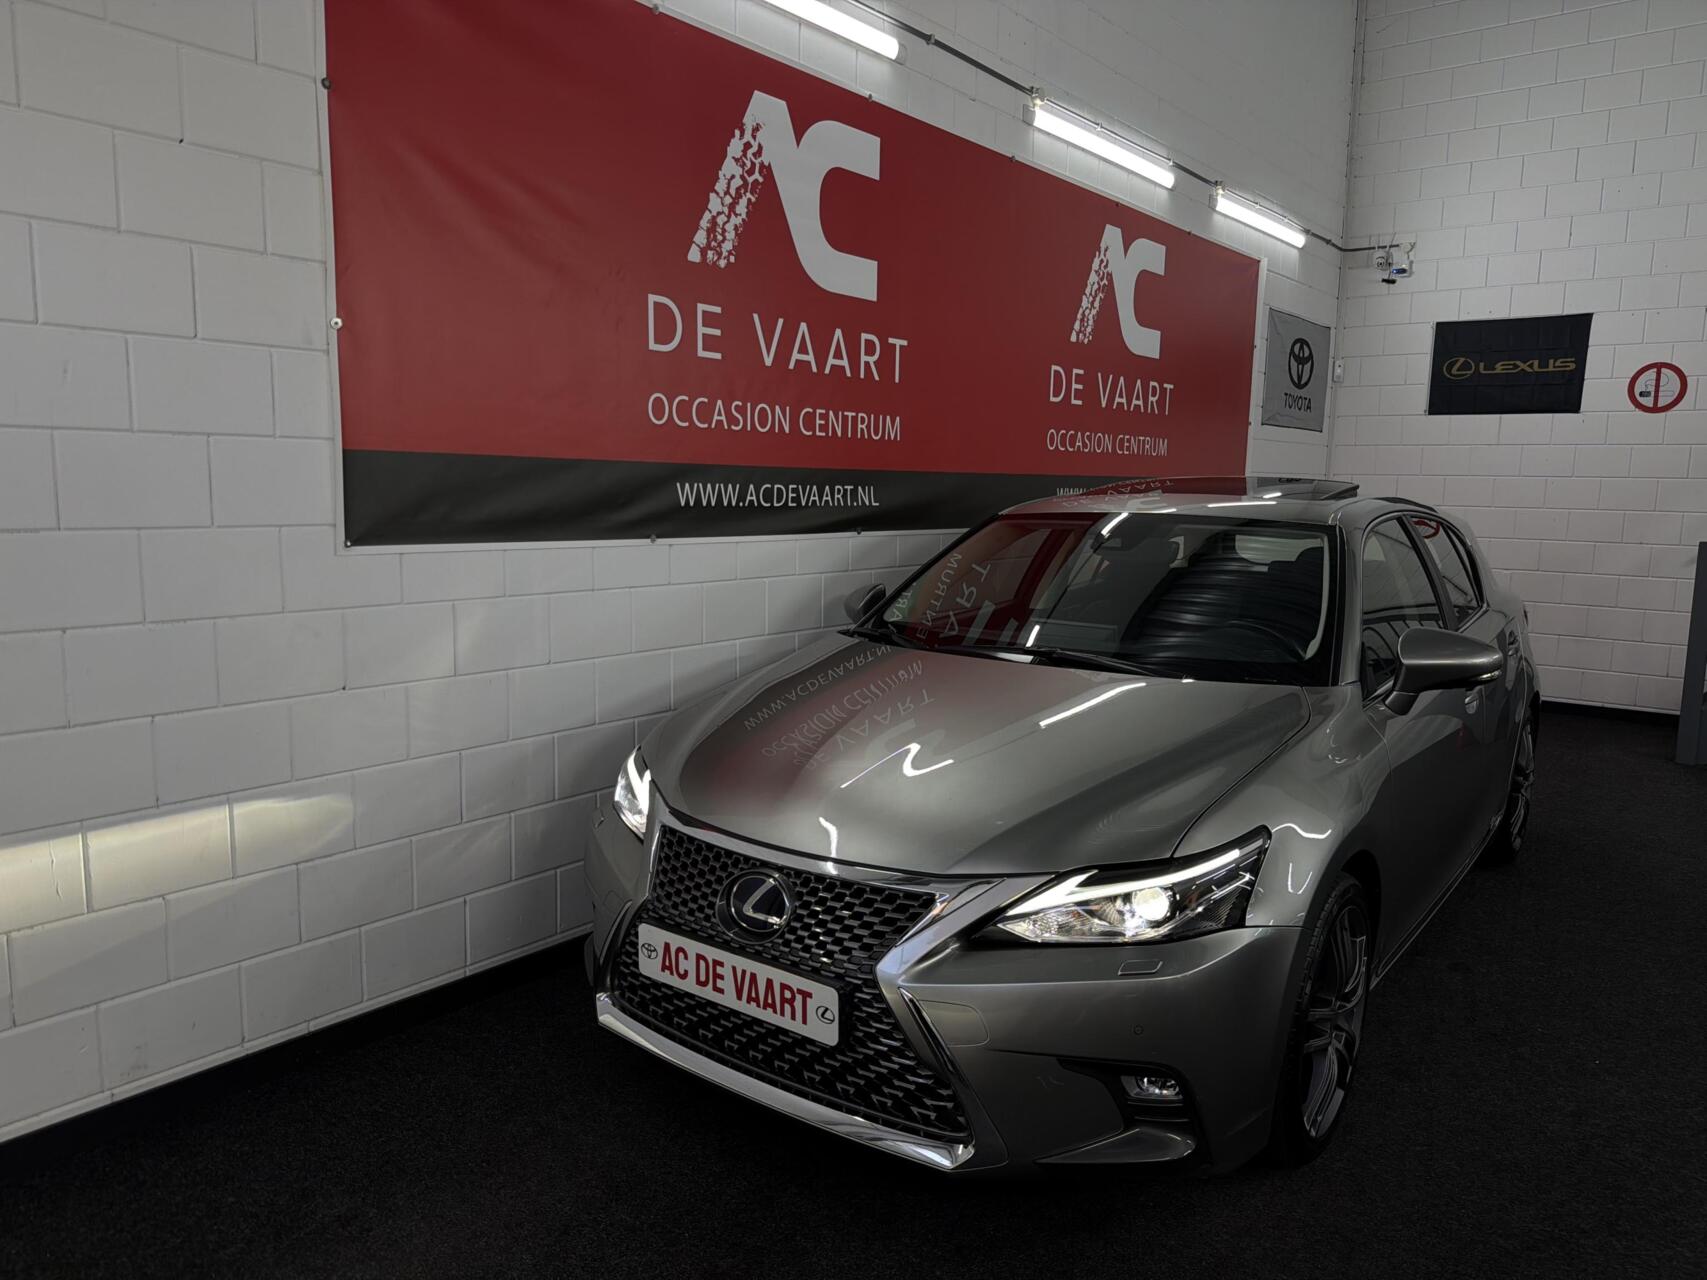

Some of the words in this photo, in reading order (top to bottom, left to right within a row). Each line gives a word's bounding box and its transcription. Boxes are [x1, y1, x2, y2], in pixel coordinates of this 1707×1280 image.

[647, 293, 723, 360] DE
[752, 313, 909, 384] VAART
[1478, 356, 1577, 376] LEXUS
[1049, 364, 1085, 405] DE
[1097, 372, 1175, 416] VAART
[1283, 391, 1313, 413] TOYOTA
[647, 392, 790, 434] OCCASION
[798, 407, 901, 441] CENTRUM
[1046, 428, 1113, 453] OCCASION
[1116, 434, 1168, 457] CENTRUM
[676, 481, 880, 507] WWW.ACDEVAART.NL
[660, 941, 689, 980] AC
[695, 952, 725, 995] DE
[731, 965, 813, 1025] VAART
